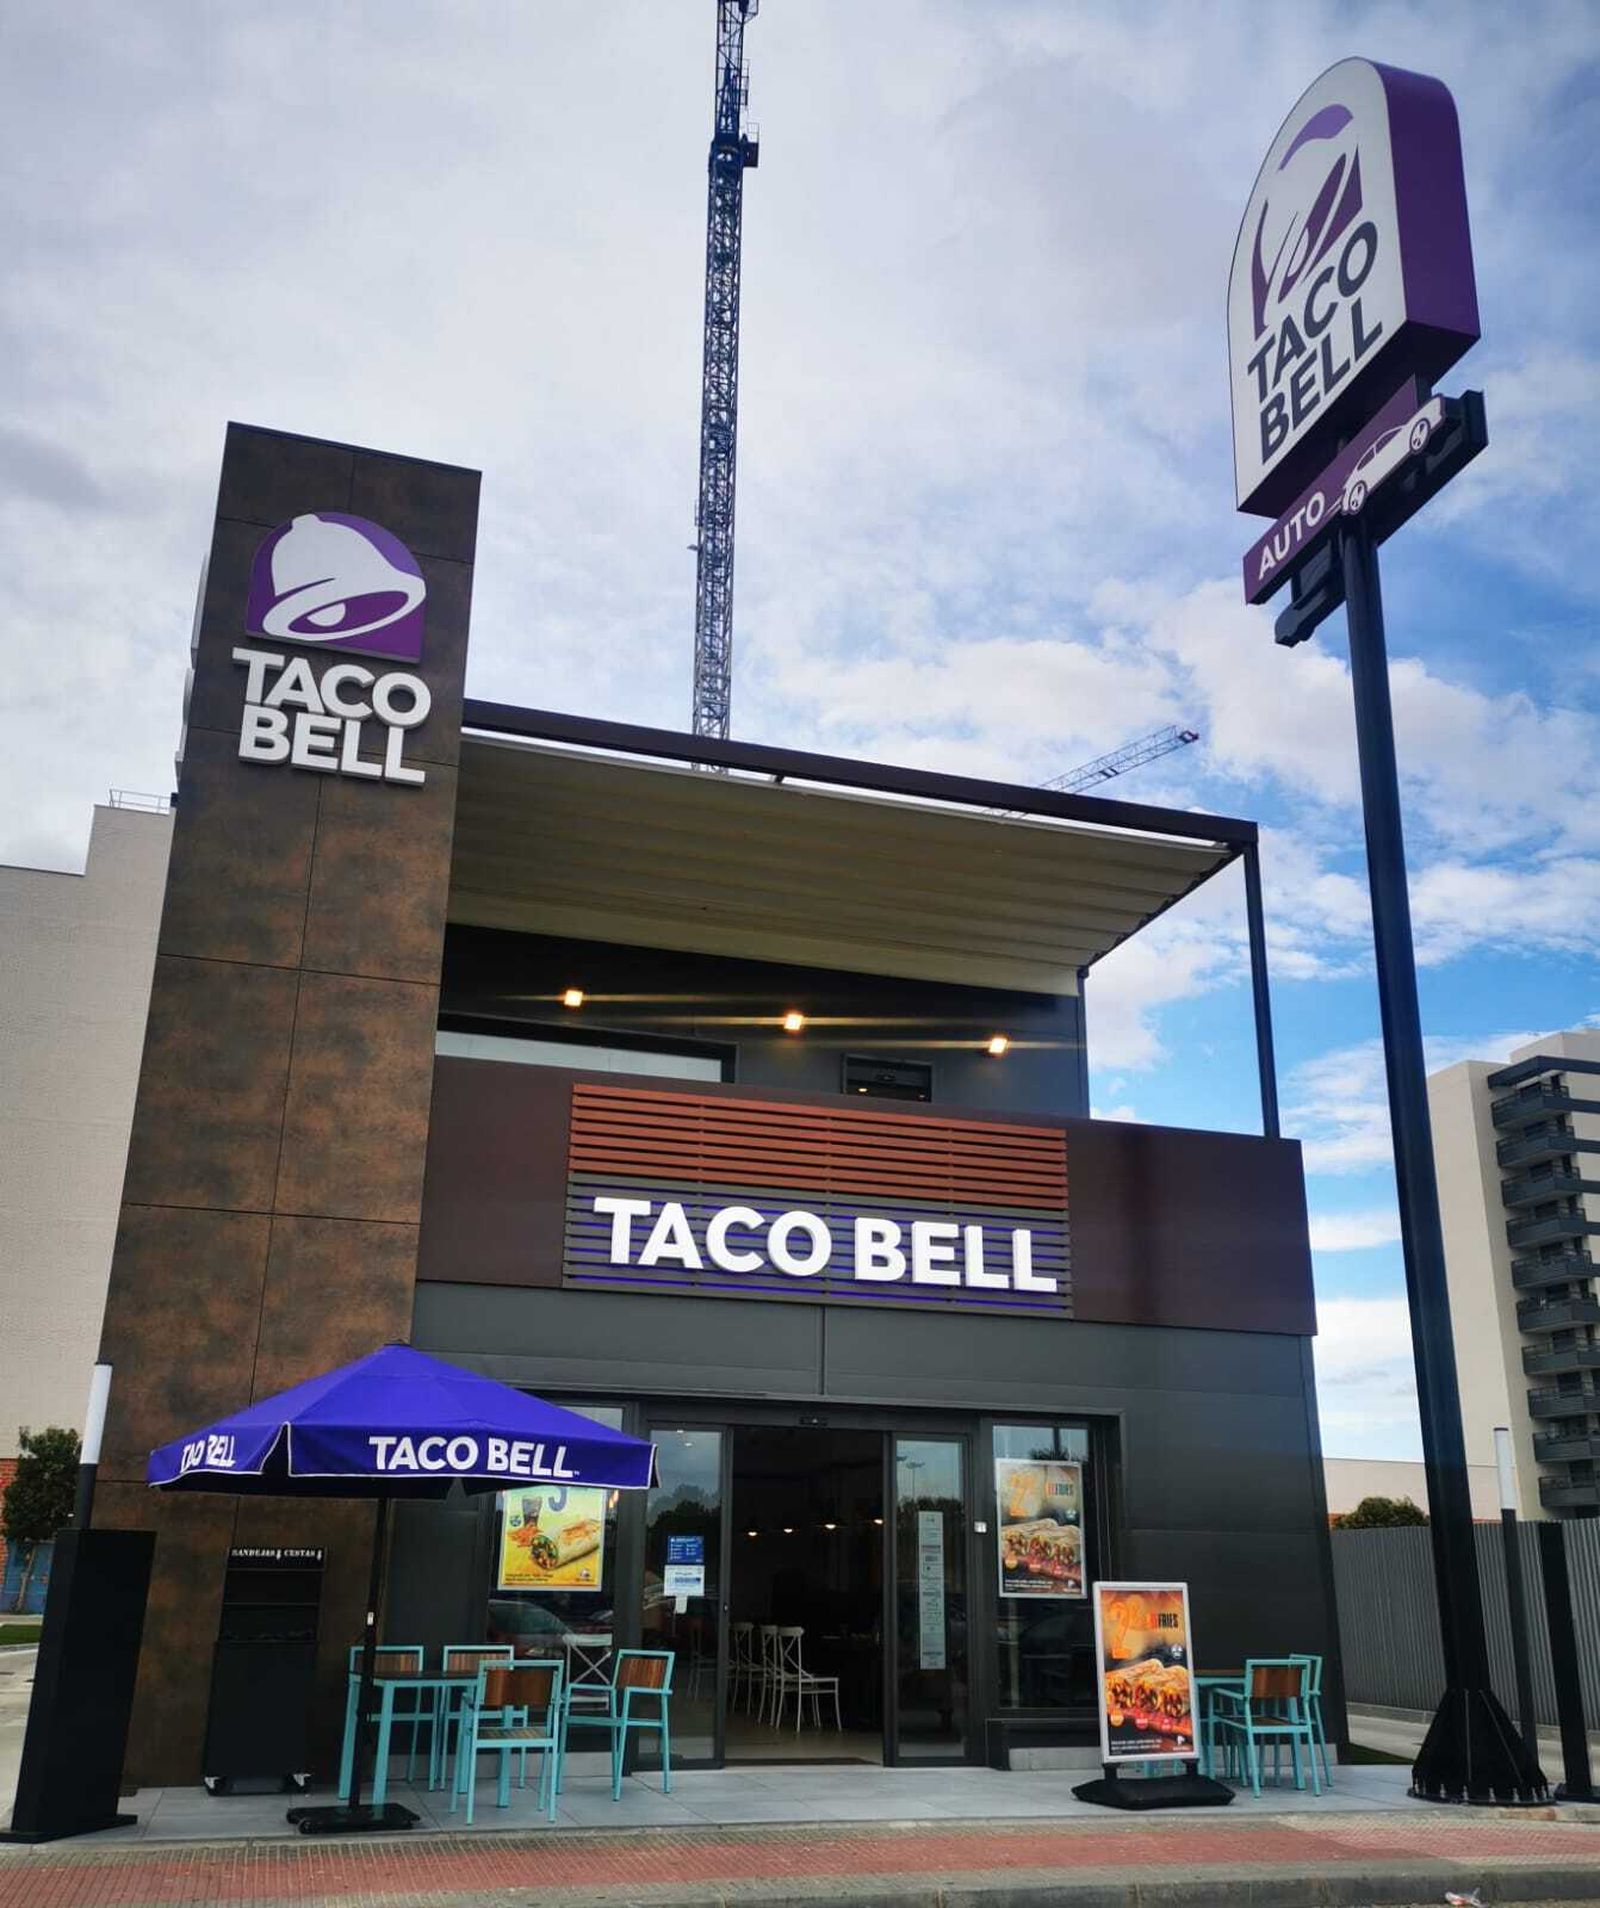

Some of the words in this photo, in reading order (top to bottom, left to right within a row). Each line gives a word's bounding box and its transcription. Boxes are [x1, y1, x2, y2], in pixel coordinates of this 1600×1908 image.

[1248, 221, 1378, 403] TACO
[1260, 297, 1383, 465] BELL
[1258, 491, 1326, 580] AUTO
[232, 647, 432, 729] TACO
[238, 703, 426, 787] BELL
[593, 1196, 832, 1277] TACO
[854, 1216, 1058, 1293] BELL
[368, 1436, 479, 1471] TACO
[487, 1437, 574, 1478] BELL
